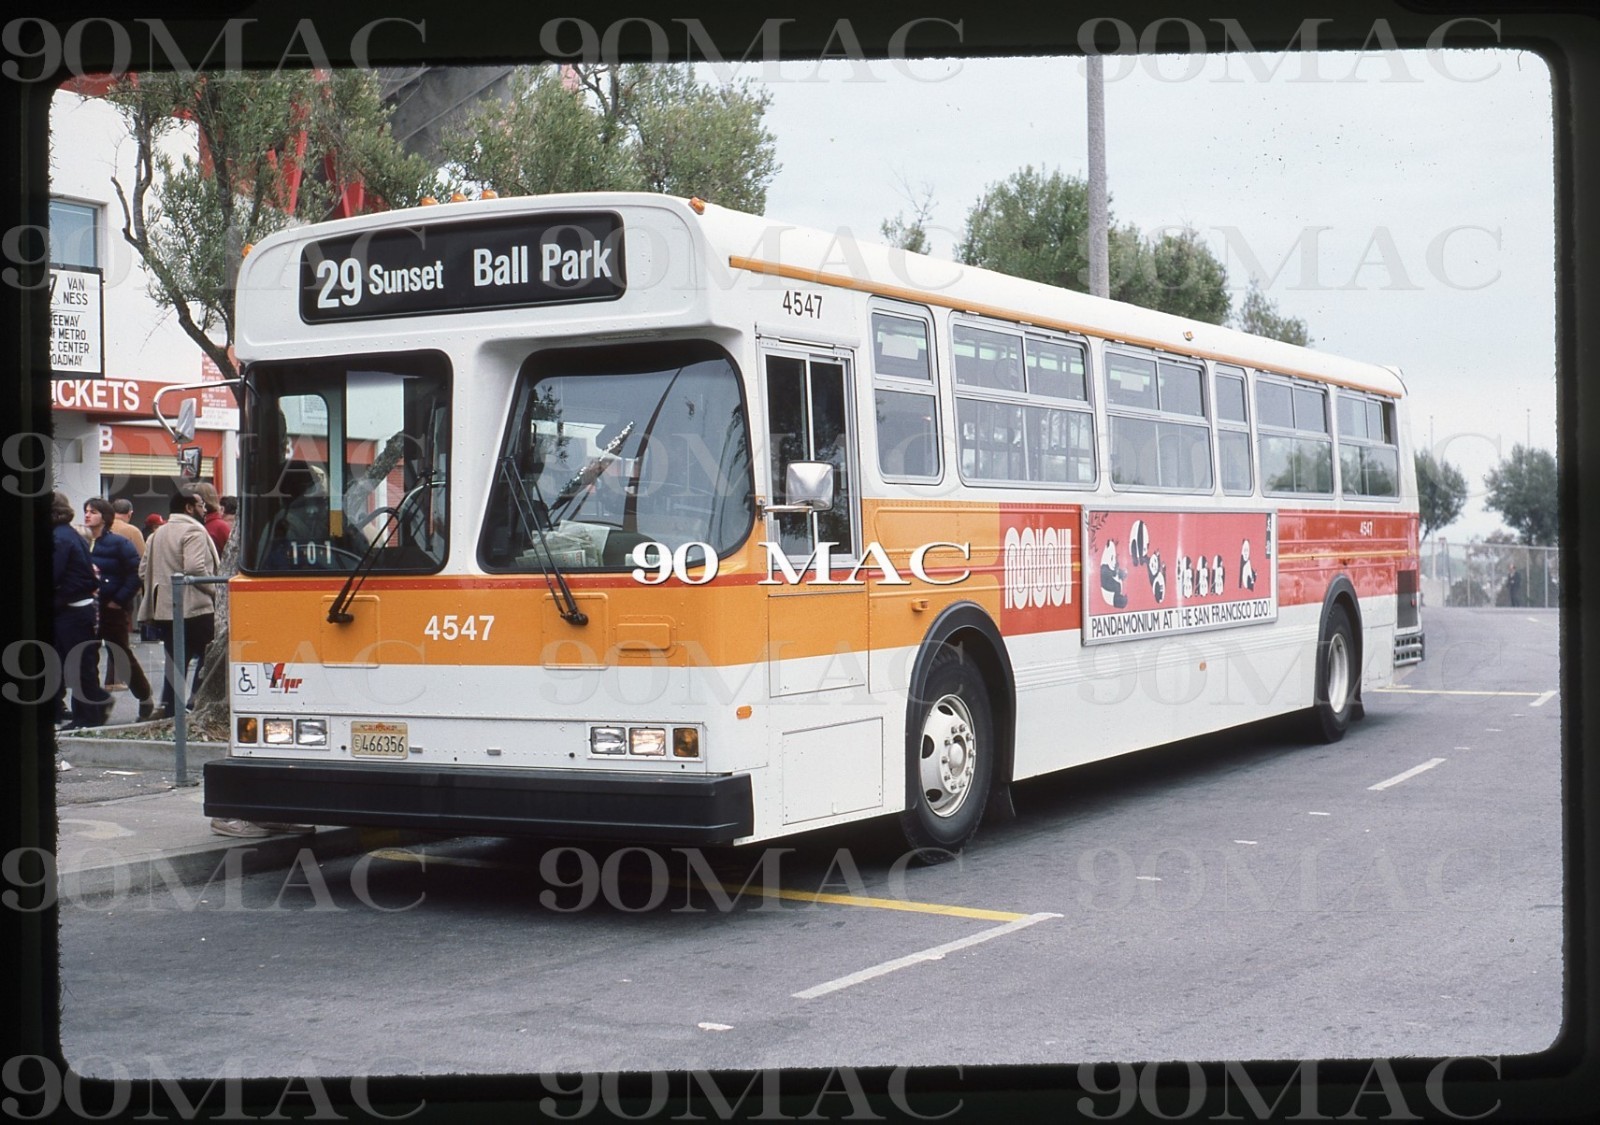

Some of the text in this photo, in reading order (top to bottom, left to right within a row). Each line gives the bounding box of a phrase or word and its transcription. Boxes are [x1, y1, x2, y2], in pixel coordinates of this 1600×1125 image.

[316, 240, 612, 309] 29 Sunset Ball Park
[67, 277, 84, 291] VAN
[63, 292, 88, 305] NESS
[782, 290, 823, 319] 4547
[52, 314, 80, 327] EEWAY
[58, 328, 86, 340] METRO
[58, 341, 89, 354] CENTER
[51, 354, 83, 366] OADWAY
[51, 379, 140, 411] ICKETS
[1359, 521, 1373, 537] 4547
[291, 540, 331, 564] 101
[424, 615, 495, 640] 4547
[1091, 600, 1272, 638] PANDAMONIUM AT THE SAN FRANCISCO ZOO!
[362, 734, 405, 752] 466356
